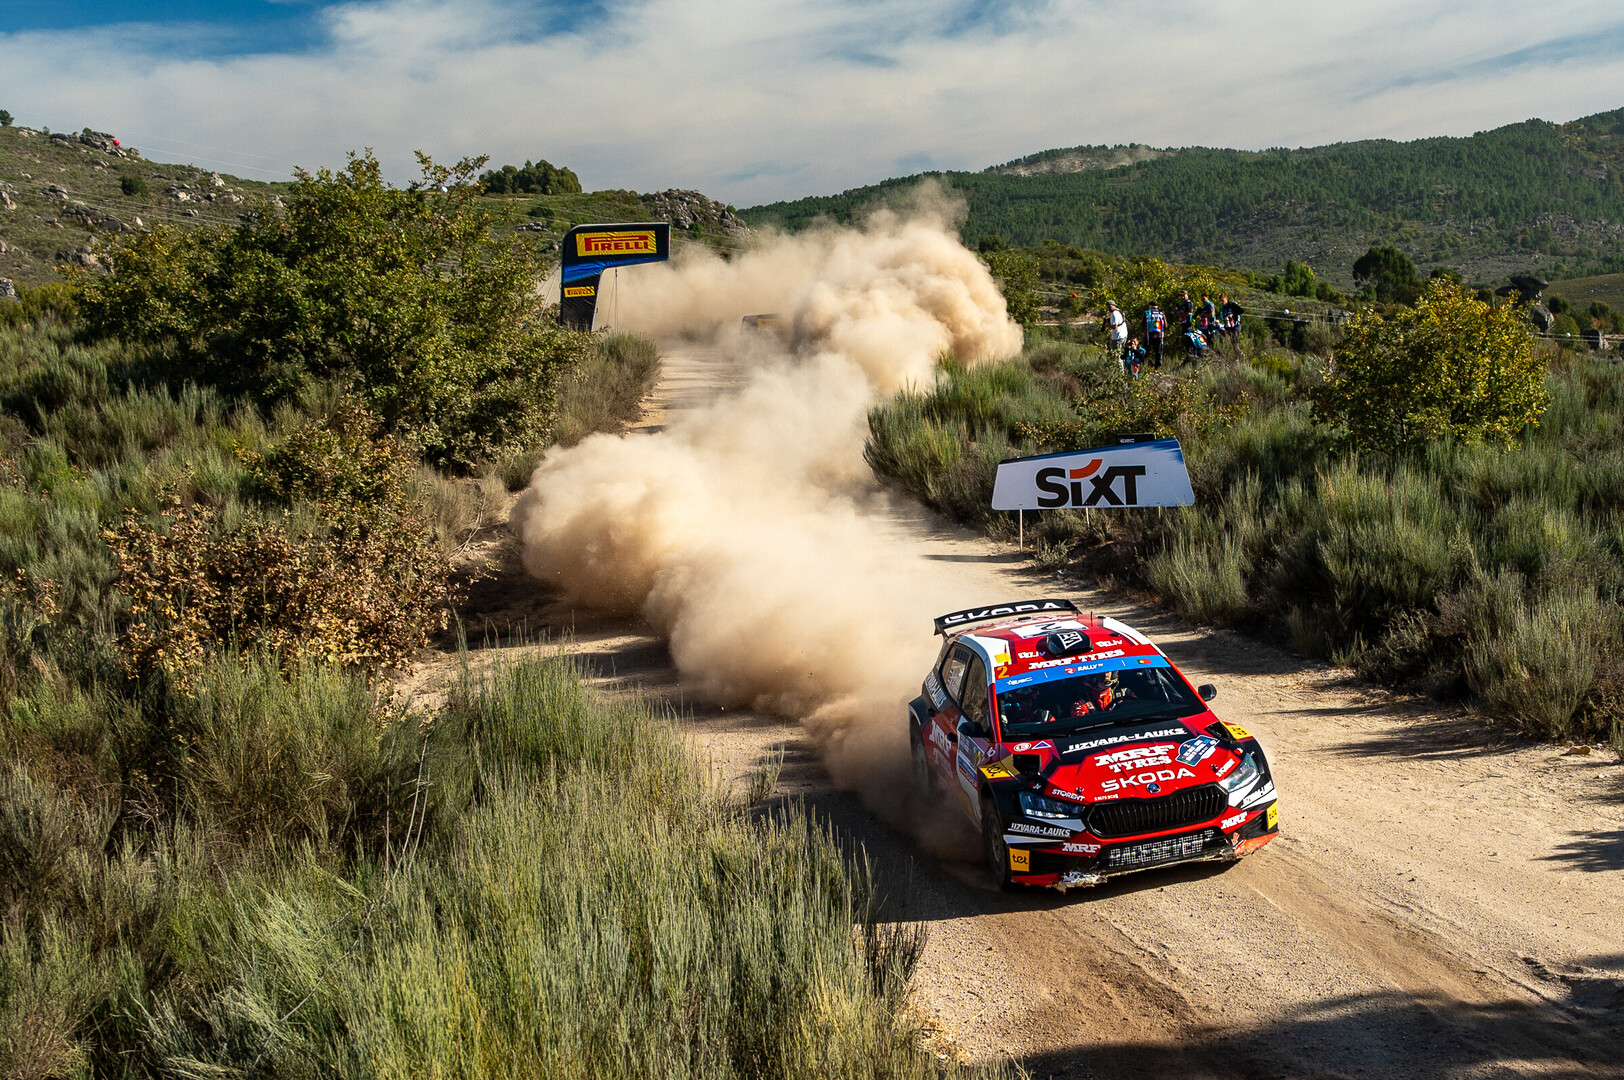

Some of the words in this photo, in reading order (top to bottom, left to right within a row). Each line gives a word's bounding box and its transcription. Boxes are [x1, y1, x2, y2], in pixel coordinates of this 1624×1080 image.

[584, 235, 649, 251] PIRELLI
[567, 288, 592, 296] PIRELLI
[1028, 656, 1076, 670] MRF
[1078, 649, 1125, 663] TYRES
[996, 666, 1010, 679] 2
[1077, 664, 1097, 672] RALLY
[1062, 727, 1187, 754] UZVARA-LAUKS
[1093, 744, 1175, 767] MRF
[1109, 755, 1173, 773] TYRES
[1052, 788, 1086, 802] STORENT
[1221, 811, 1248, 829] MRF
[1008, 822, 1071, 837] UZVARA-LAUKS
[1062, 842, 1101, 854] MRF
[1011, 853, 1029, 865] tet
